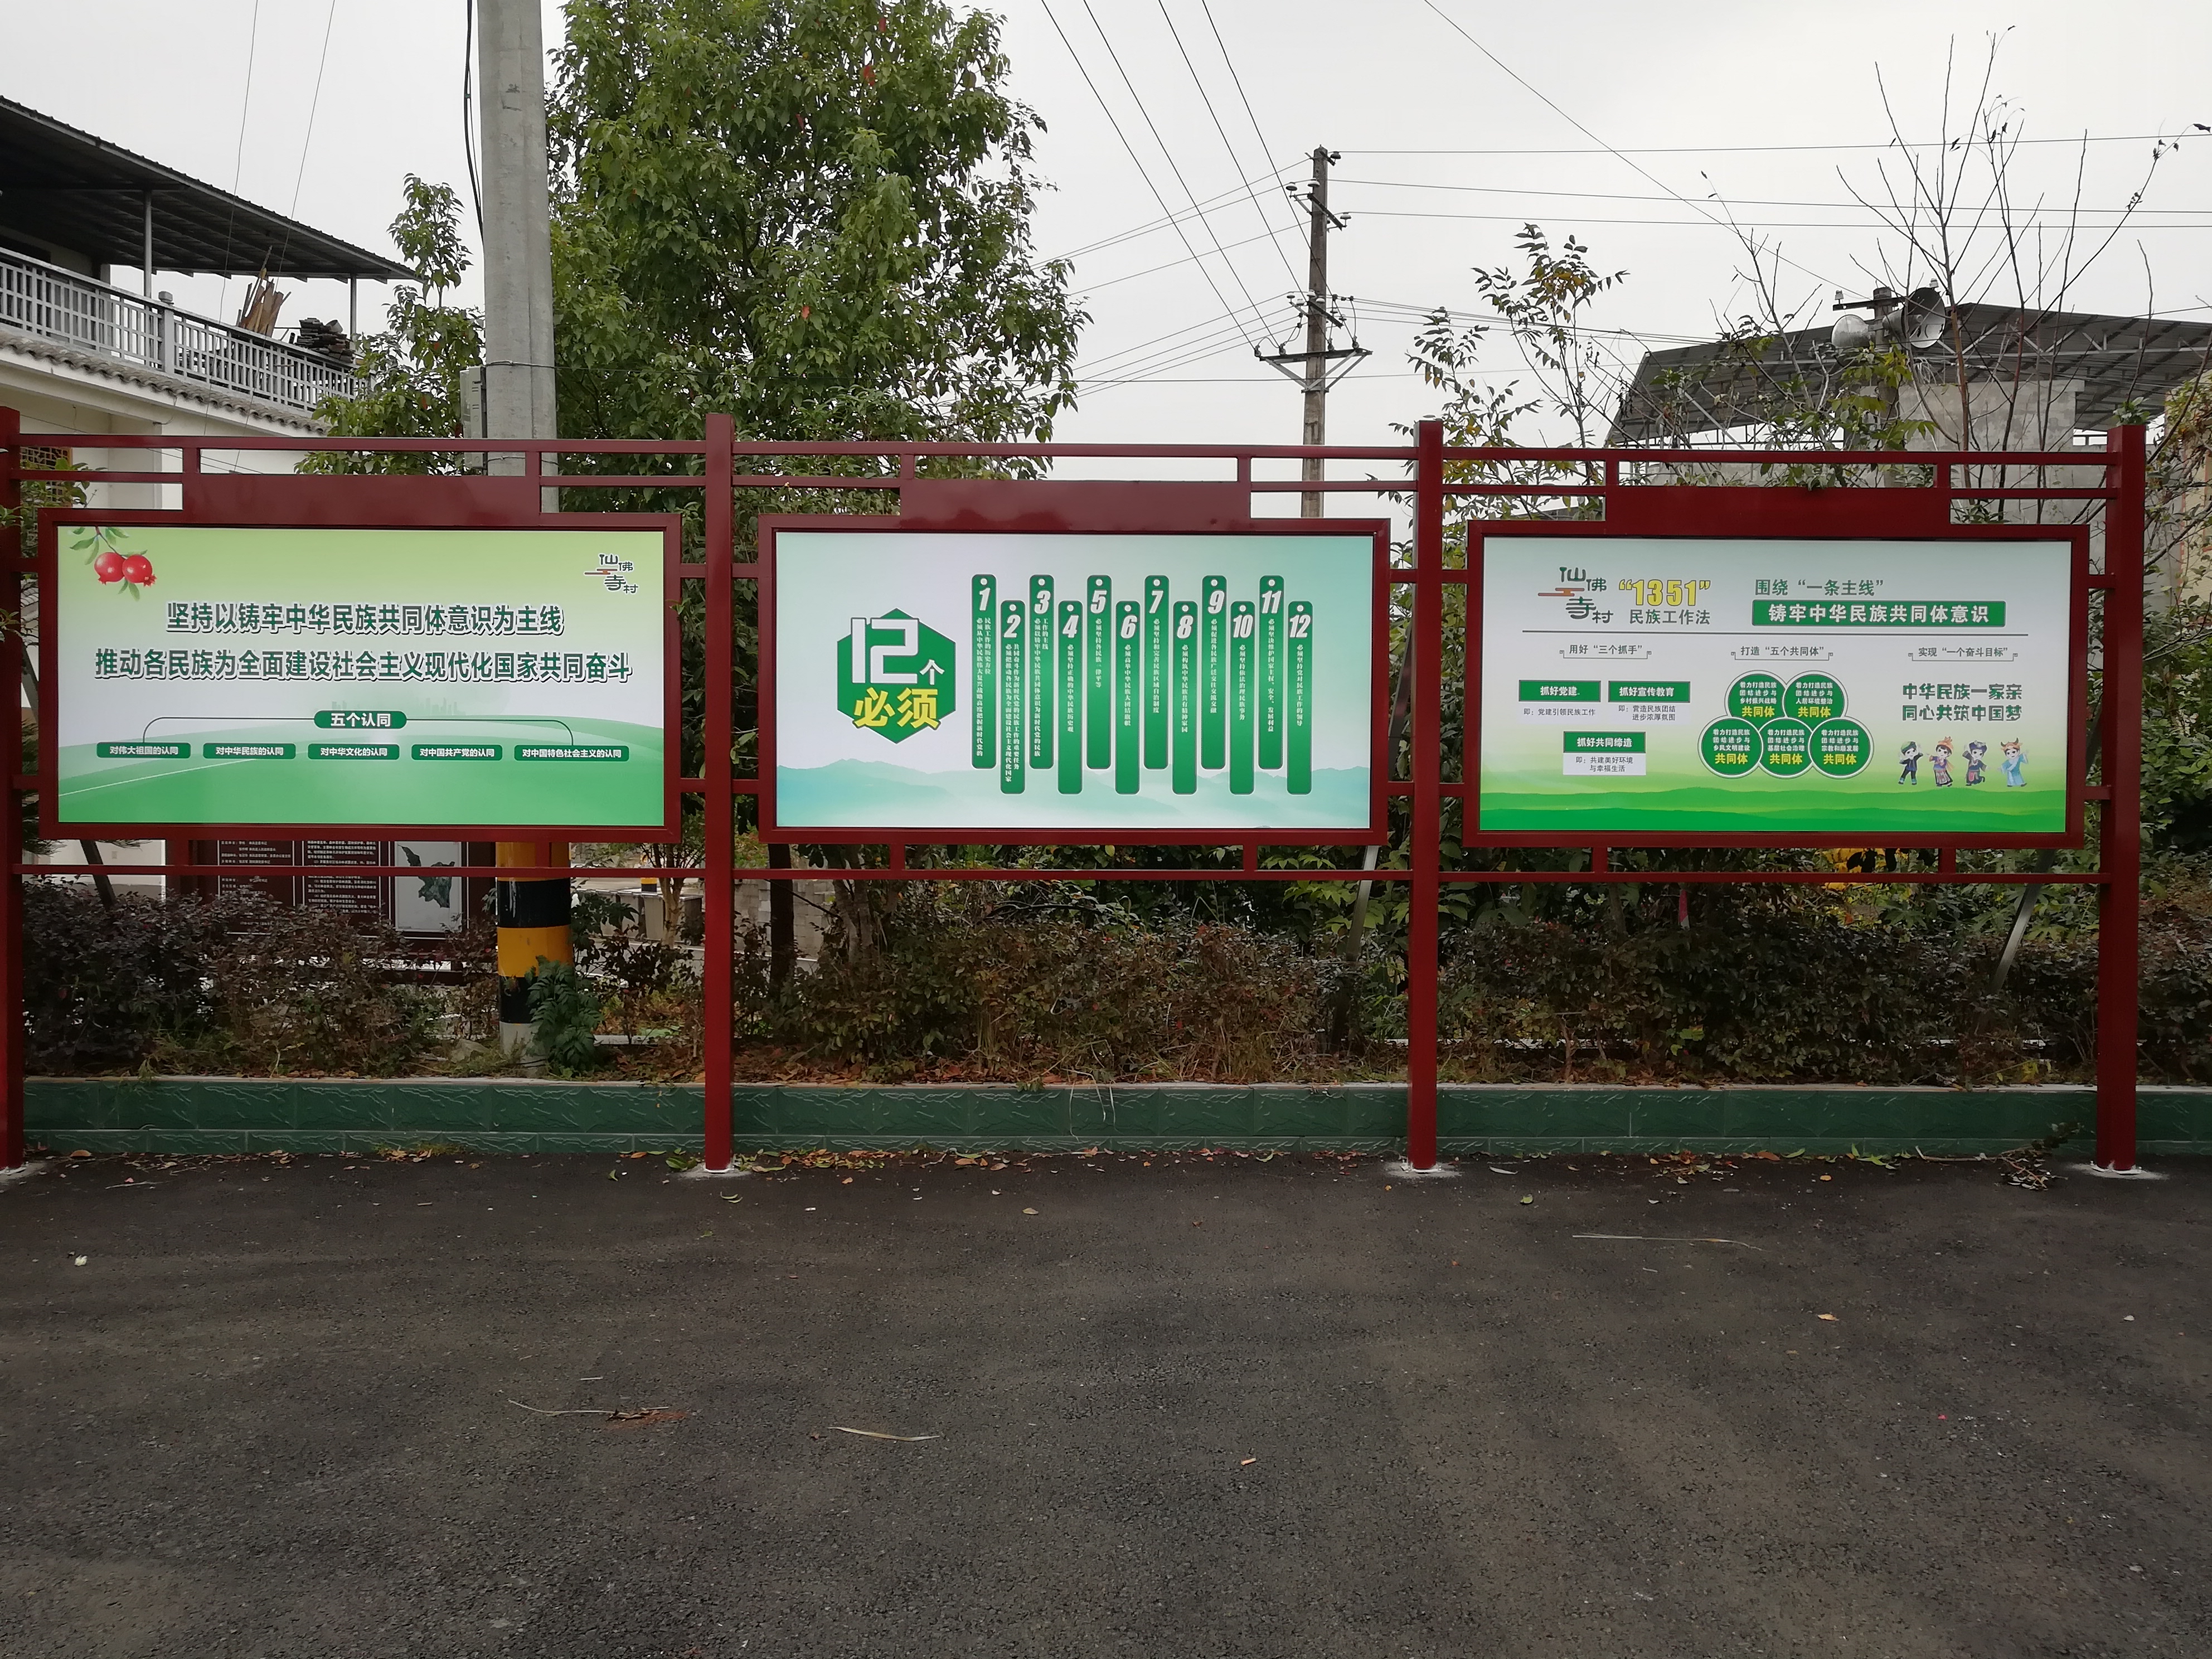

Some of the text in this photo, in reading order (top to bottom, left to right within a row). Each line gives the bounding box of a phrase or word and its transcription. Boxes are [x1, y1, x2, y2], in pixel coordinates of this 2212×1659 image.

[978, 588, 991, 611] 1
[1034, 590, 1051, 614] 3
[1090, 589, 1108, 614] 5
[1149, 590, 1164, 614] 7
[1207, 590, 1225, 614] 9
[1262, 590, 1282, 614] 11
[167, 602, 564, 634] 坚持以铸牢中华民族共同体意识为主线
[1629, 609, 1711, 625] 民族工作法
[1768, 603, 1990, 623] 铸牢中华民族共同体意识
[1003, 614, 1021, 638] 2
[1062, 614, 1079, 638] 4
[1120, 614, 1138, 639] 6
[1177, 614, 1194, 638] 8
[1233, 614, 1254, 638] 10
[1289, 614, 1311, 638] 12
[95, 648, 632, 682] 推动各民族为全面建设社会主义现代化国家共同奋斗
[1540, 686, 1578, 697] 抓好党建
[1619, 686, 1675, 697] 抓好宣传教育
[1902, 683, 2023, 700] 中华民族一家亲
[852, 686, 942, 730] 必须
[1742, 706, 1776, 718] 共同体
[1798, 706, 1831, 718] 共同体
[1902, 705, 2023, 722] 同心共筑中国梦
[330, 712, 391, 727] 五个认同
[1632, 713, 1676, 721] 进步浓厚氛围
[109, 745, 179, 756] 对伟大祖国的认同
[215, 746, 284, 756] 对中华民族的认同
[1576, 737, 1633, 748] 抓好共同缔造
[320, 746, 388, 758] 对中华文化的认同
[419, 748, 495, 758] 对中国共产党的认同
[522, 748, 622, 759] 对中国特色社会主义的认同
[1715, 753, 1748, 765] 共同体
[1769, 753, 1803, 765] 共同体
[1823, 753, 1857, 765] 共同体
[1589, 764, 1626, 773] 与幸福生活
